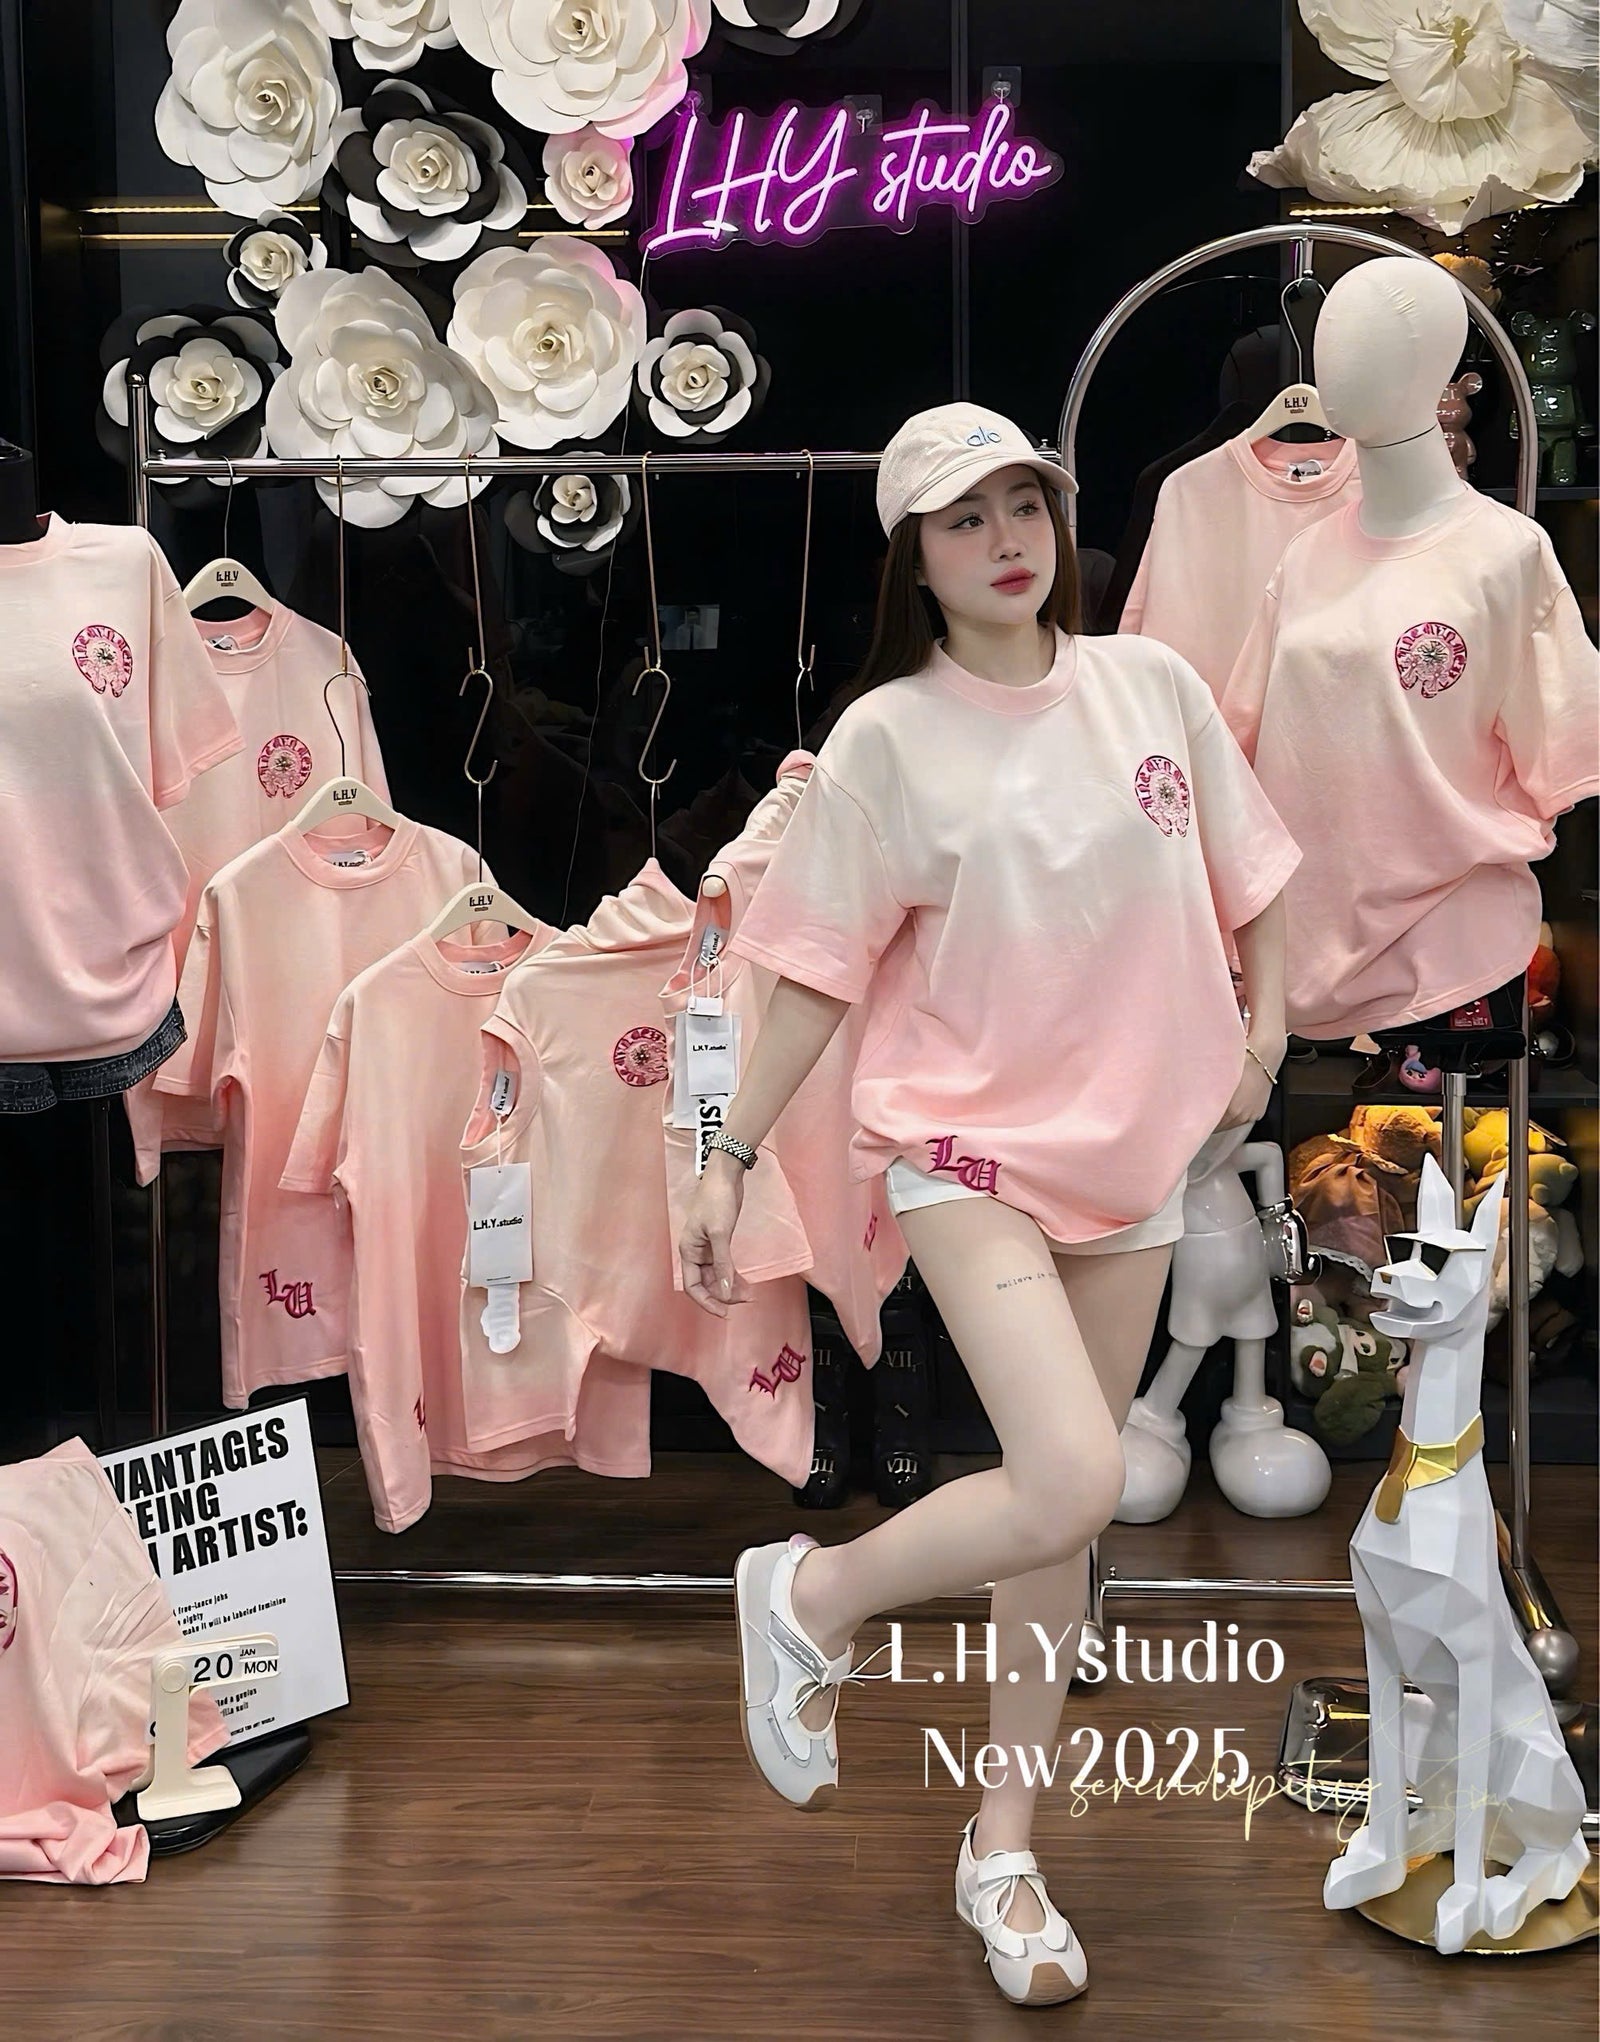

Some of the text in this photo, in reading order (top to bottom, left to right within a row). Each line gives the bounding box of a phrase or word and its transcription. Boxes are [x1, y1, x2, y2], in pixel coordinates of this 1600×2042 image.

[646, 102, 1052, 251] LHY studio
[966, 425, 1002, 447] alo
[123, 1482, 221, 1540] EING
[173, 1499, 309, 1576] ARTIST:
[193, 1648, 256, 1683] 20 JAN
[244, 1659, 278, 1675] MON
